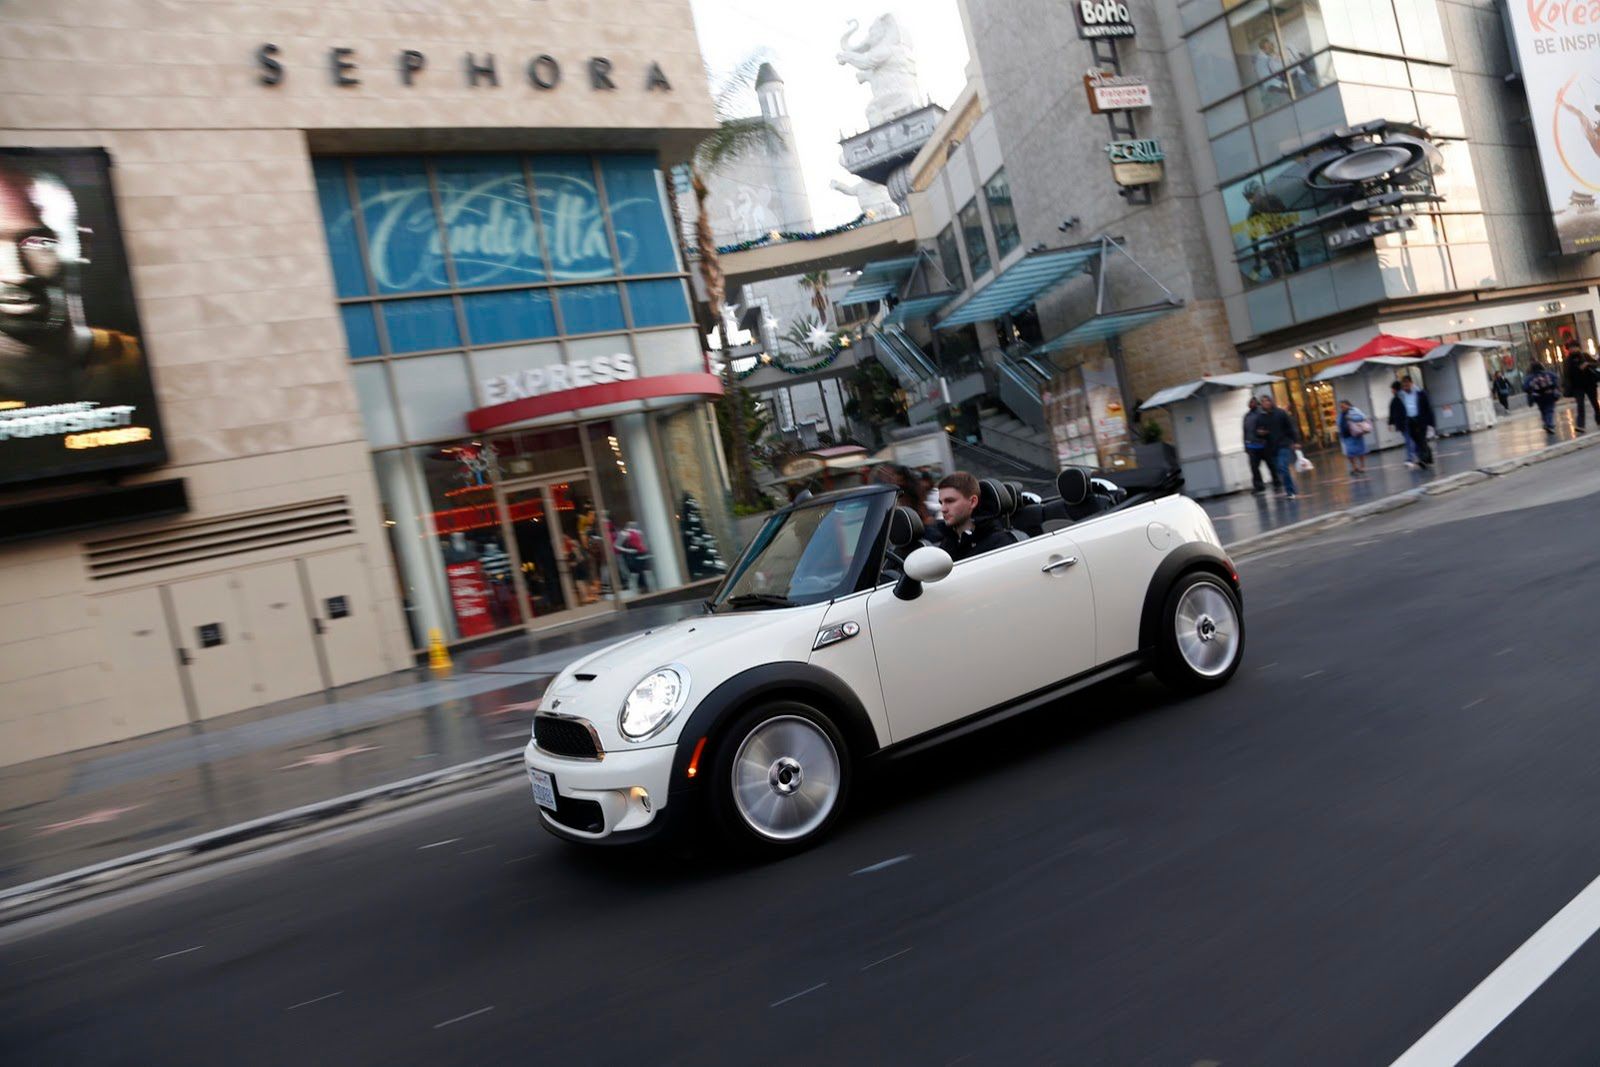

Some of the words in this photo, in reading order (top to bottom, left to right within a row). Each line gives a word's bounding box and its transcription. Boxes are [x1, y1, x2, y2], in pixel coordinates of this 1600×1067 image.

[256, 43, 673, 91] SEPHORA
[1534, 38, 1557, 55] BE
[481, 353, 636, 406] EXPRESS
